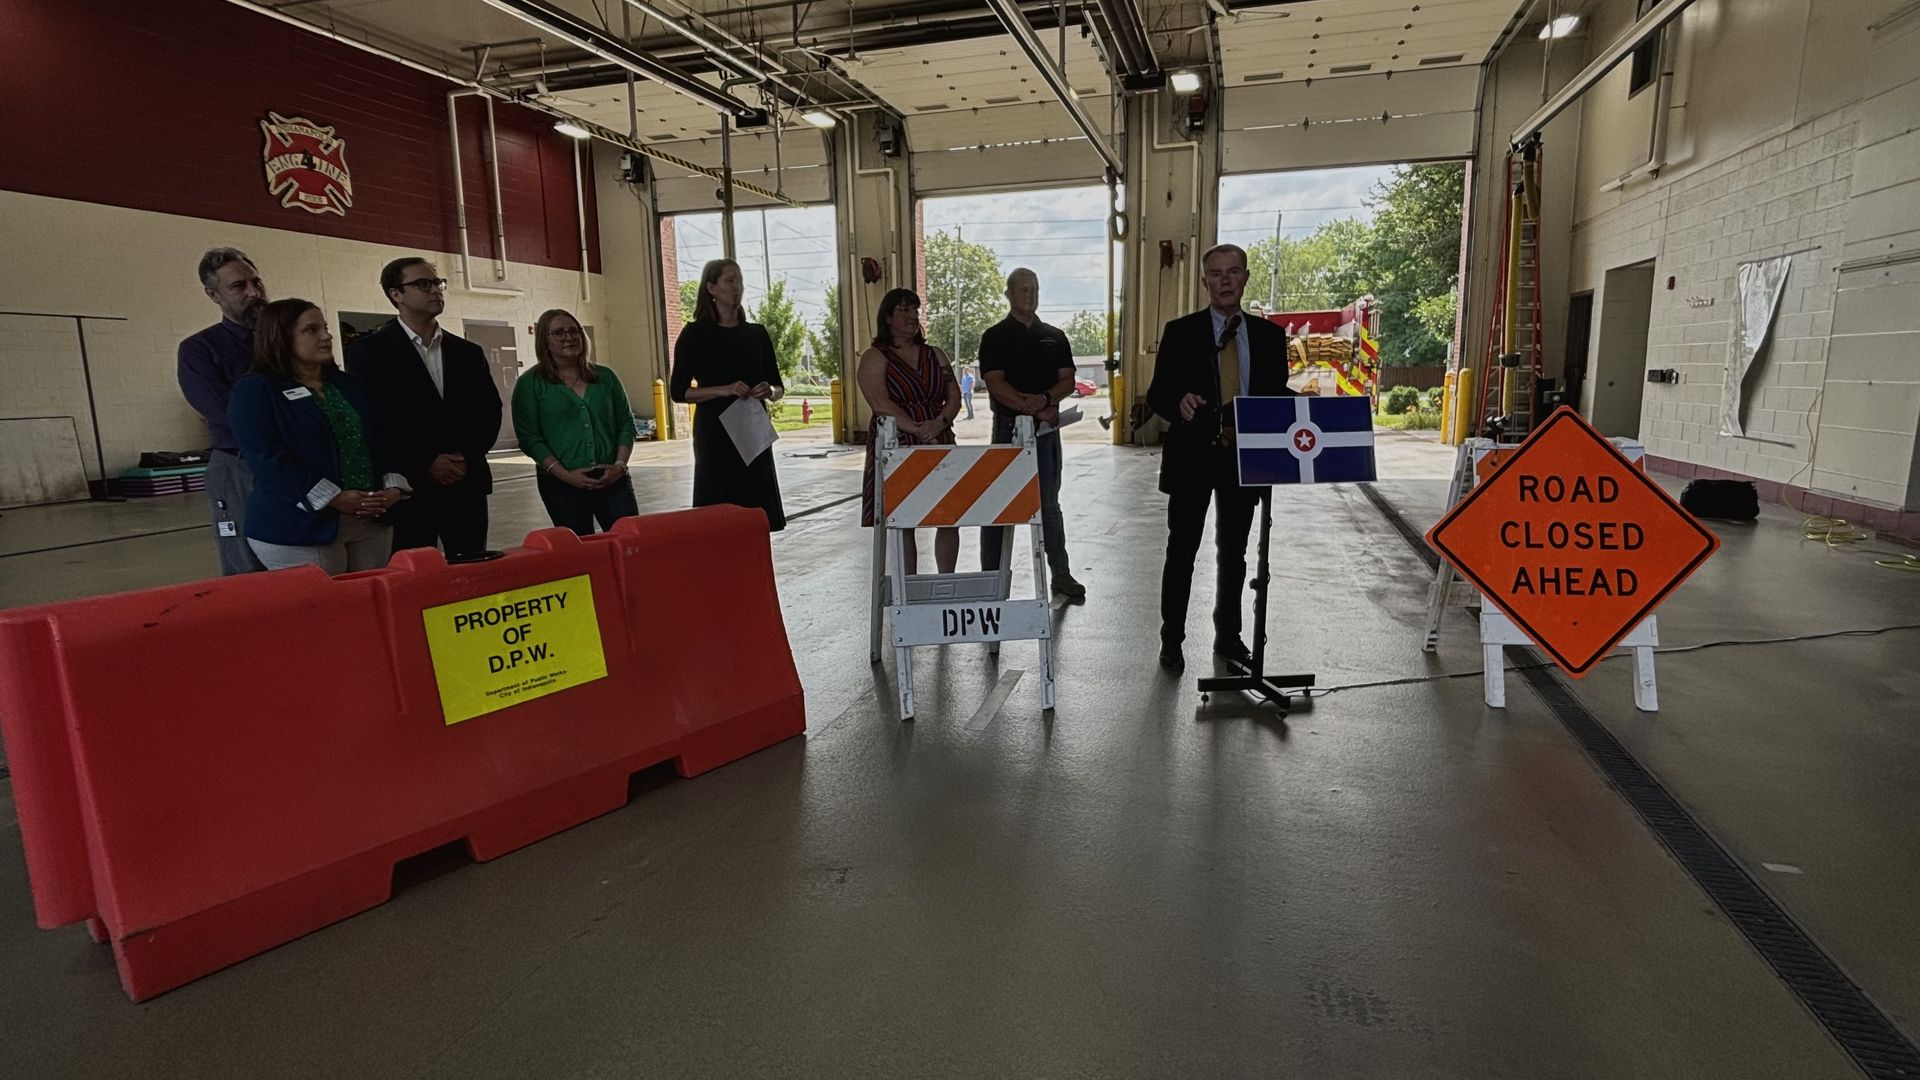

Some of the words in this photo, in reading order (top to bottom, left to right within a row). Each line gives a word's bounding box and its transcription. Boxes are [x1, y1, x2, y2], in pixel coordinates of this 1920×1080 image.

[1518, 475, 1620, 503] ROAD
[1500, 520, 1645, 551] CLOSED
[1511, 566, 1638, 597] AHEAD
[453, 592, 568, 634] PROPERTY
[942, 607, 1001, 636] DPW
[503, 623, 532, 646] OF
[488, 642, 555, 674] D.P.W.
[485, 682, 520, 697] Department
[521, 679, 529, 687] of
[530, 674, 548, 685] Public
[549, 669, 567, 679] Works
[499, 690, 511, 699] City
[522, 678, 556, 692] Indianapolis
